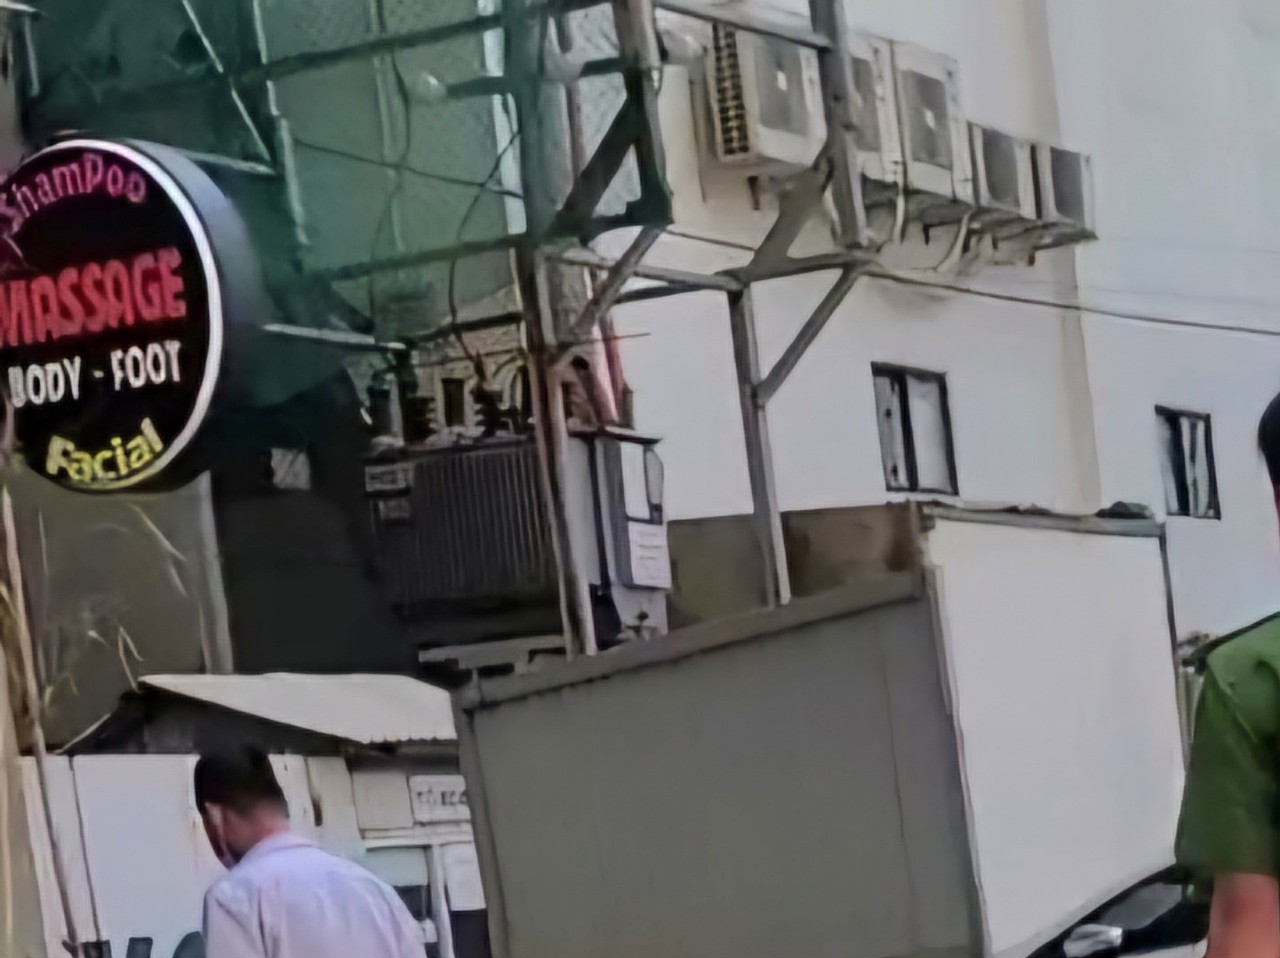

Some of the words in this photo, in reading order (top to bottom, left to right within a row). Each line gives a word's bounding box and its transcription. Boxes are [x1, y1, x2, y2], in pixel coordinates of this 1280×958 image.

[0, 248, 187, 348] MASSAGE
[8, 355, 82, 408] BODY
[110, 340, 181, 391] FOOT
[46, 416, 164, 482] Facial
